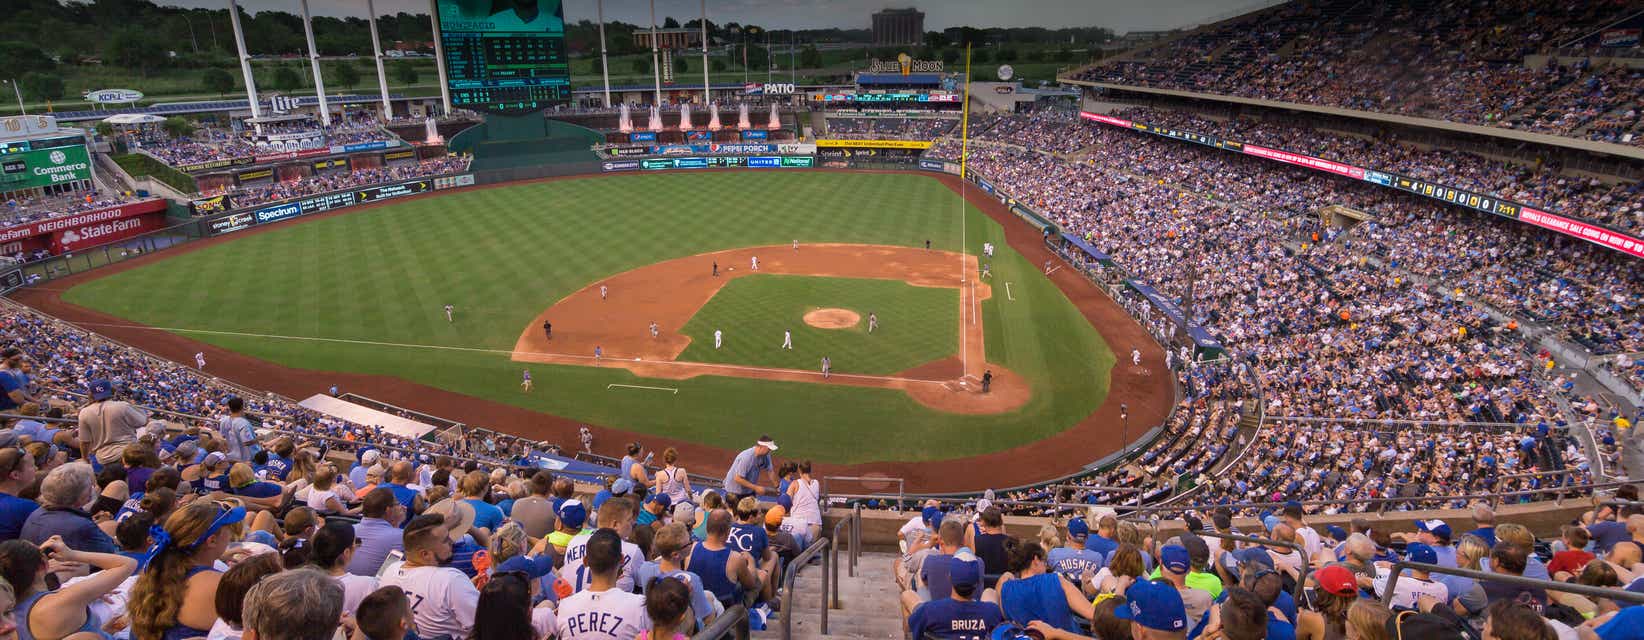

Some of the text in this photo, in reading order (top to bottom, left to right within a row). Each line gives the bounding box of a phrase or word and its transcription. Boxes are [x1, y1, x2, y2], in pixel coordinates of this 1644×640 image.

[869, 58, 943, 74] BLUE MOON
[764, 83, 794, 94] PATIO
[33, 163, 87, 176] Commerce
[51, 171, 77, 182] Bank
[1411, 182, 1418, 191] 4
[1436, 188, 1443, 197] 0
[1459, 193, 1465, 203] 0
[1482, 199, 1489, 209] 0
[258, 205, 298, 221] Spectrum
[1498, 204, 1515, 216] 7:11
[38, 208, 122, 233] NEIGHBORHOOD
[1541, 215, 1570, 230] CLEARANCE
[1569, 224, 1584, 234] SALE
[726, 526, 753, 552] KC
[1059, 558, 1097, 572] HOSMER
[567, 611, 624, 638] PEREZ
[951, 619, 986, 631] BRUZA
